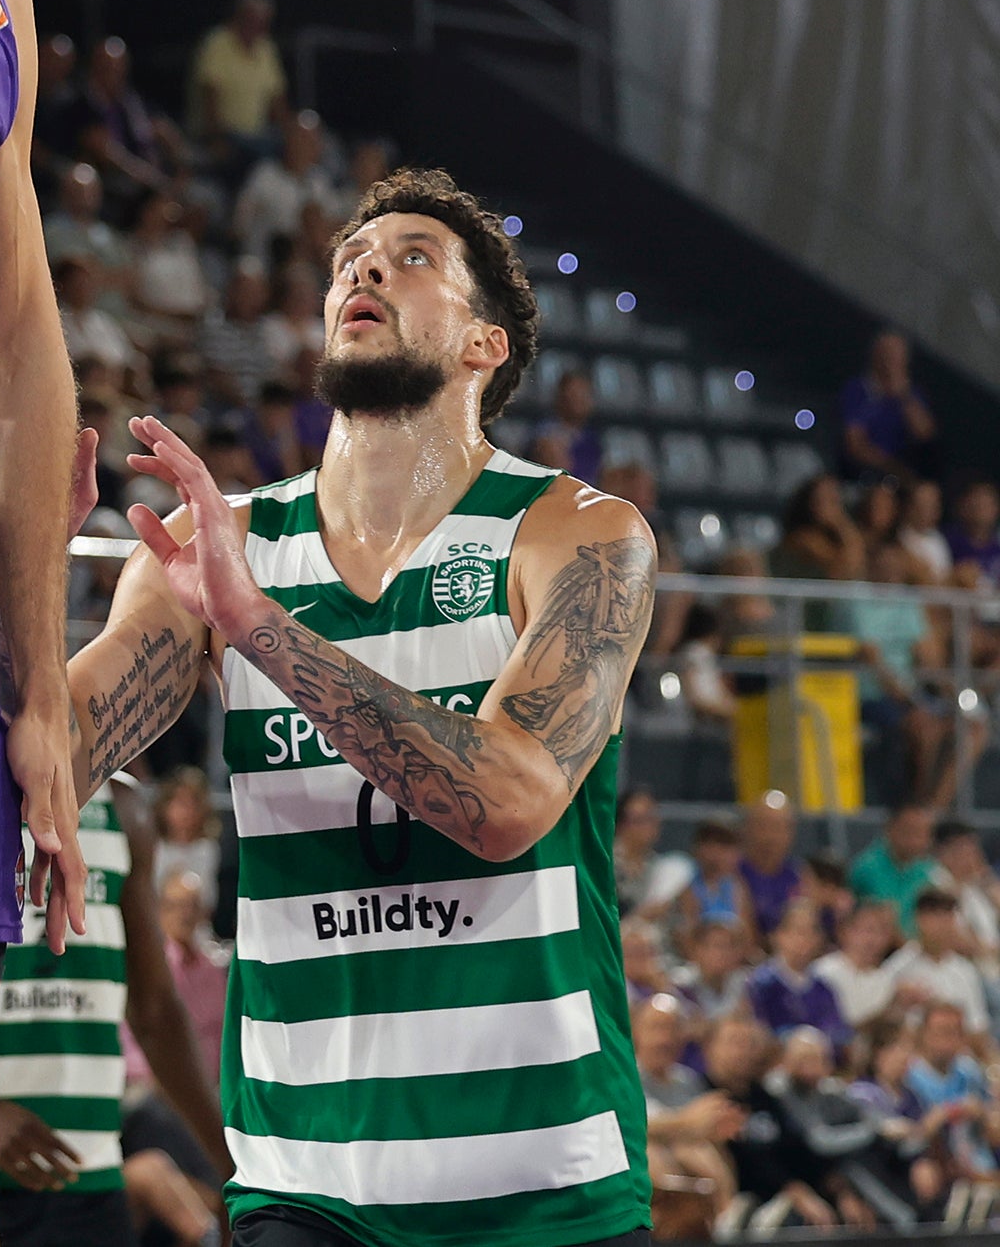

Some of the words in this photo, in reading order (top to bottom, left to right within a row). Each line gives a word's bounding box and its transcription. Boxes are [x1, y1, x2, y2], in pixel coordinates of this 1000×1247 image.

[447, 542, 493, 556] SCP
[440, 559, 491, 577] SPORTING
[441, 599, 487, 615] PORTUGAL
[313, 895, 474, 940] Buildty.
